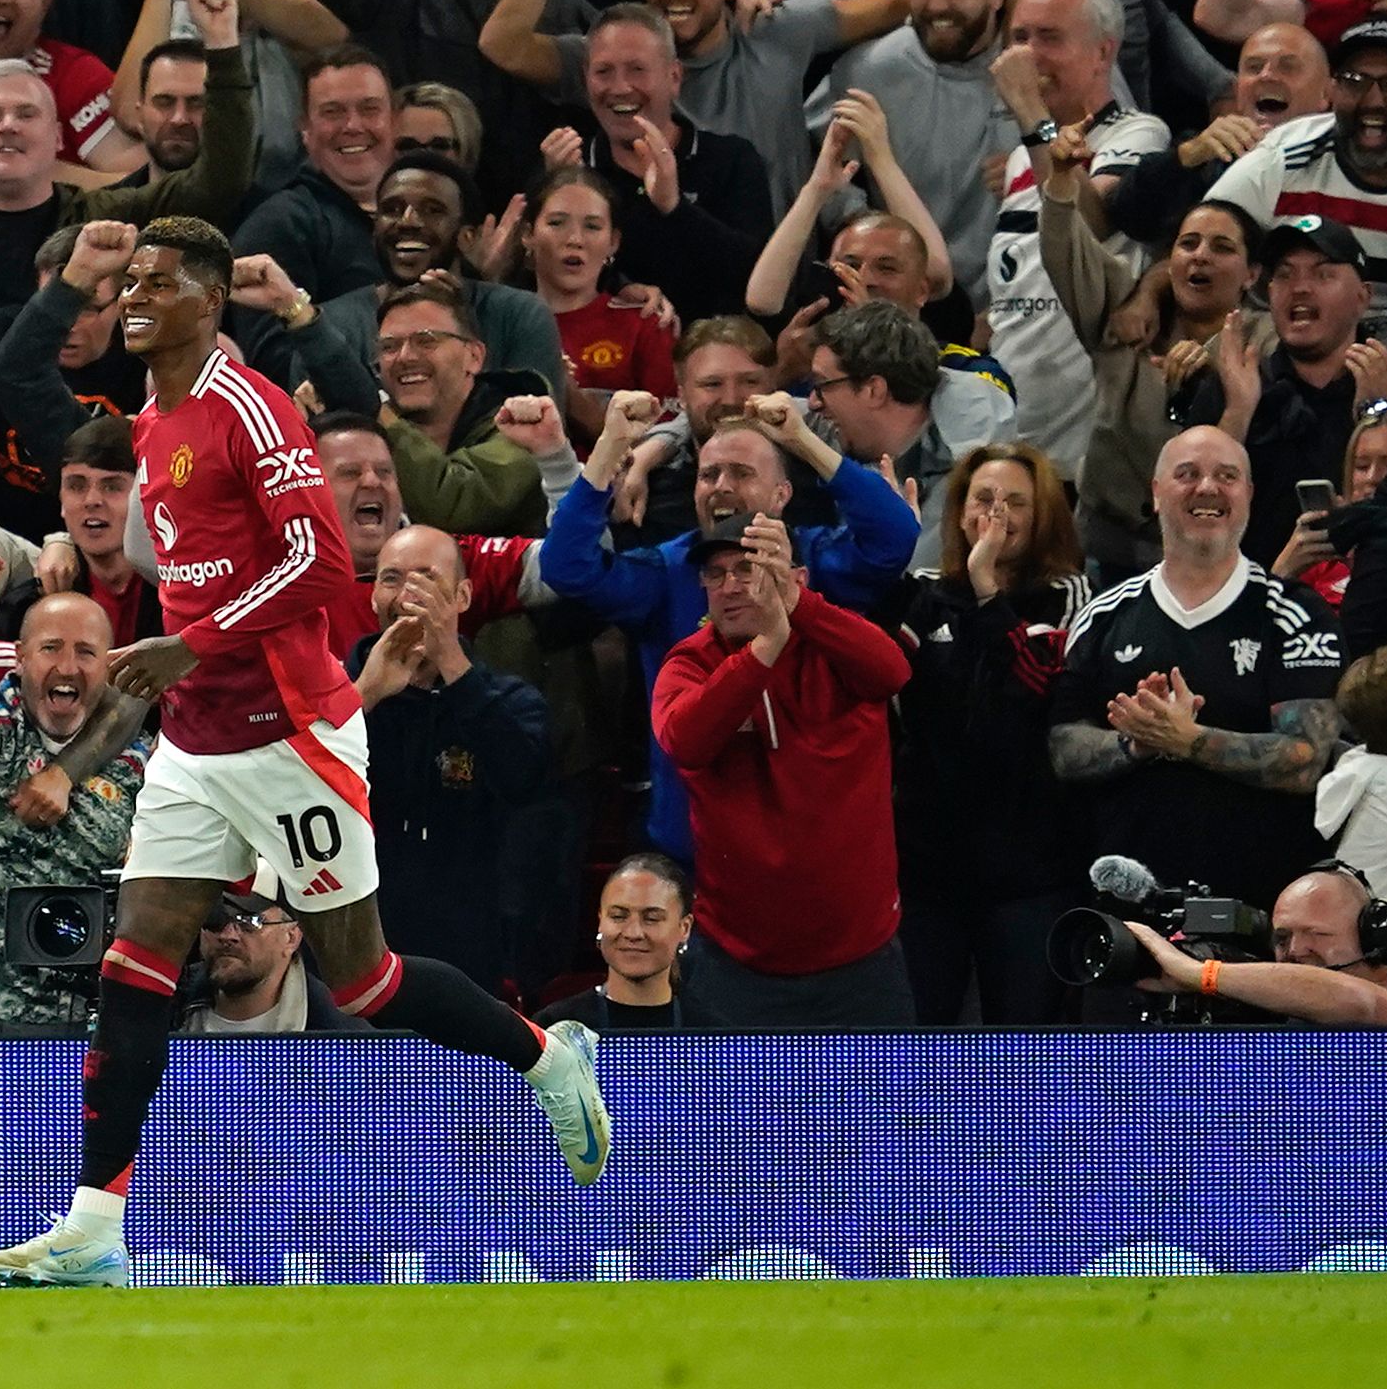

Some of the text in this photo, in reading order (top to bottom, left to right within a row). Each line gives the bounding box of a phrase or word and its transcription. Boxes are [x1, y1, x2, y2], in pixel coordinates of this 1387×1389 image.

[255, 447, 322, 489] DXC
[1281, 632, 1341, 661] DXC
[276, 805, 342, 868] 10
